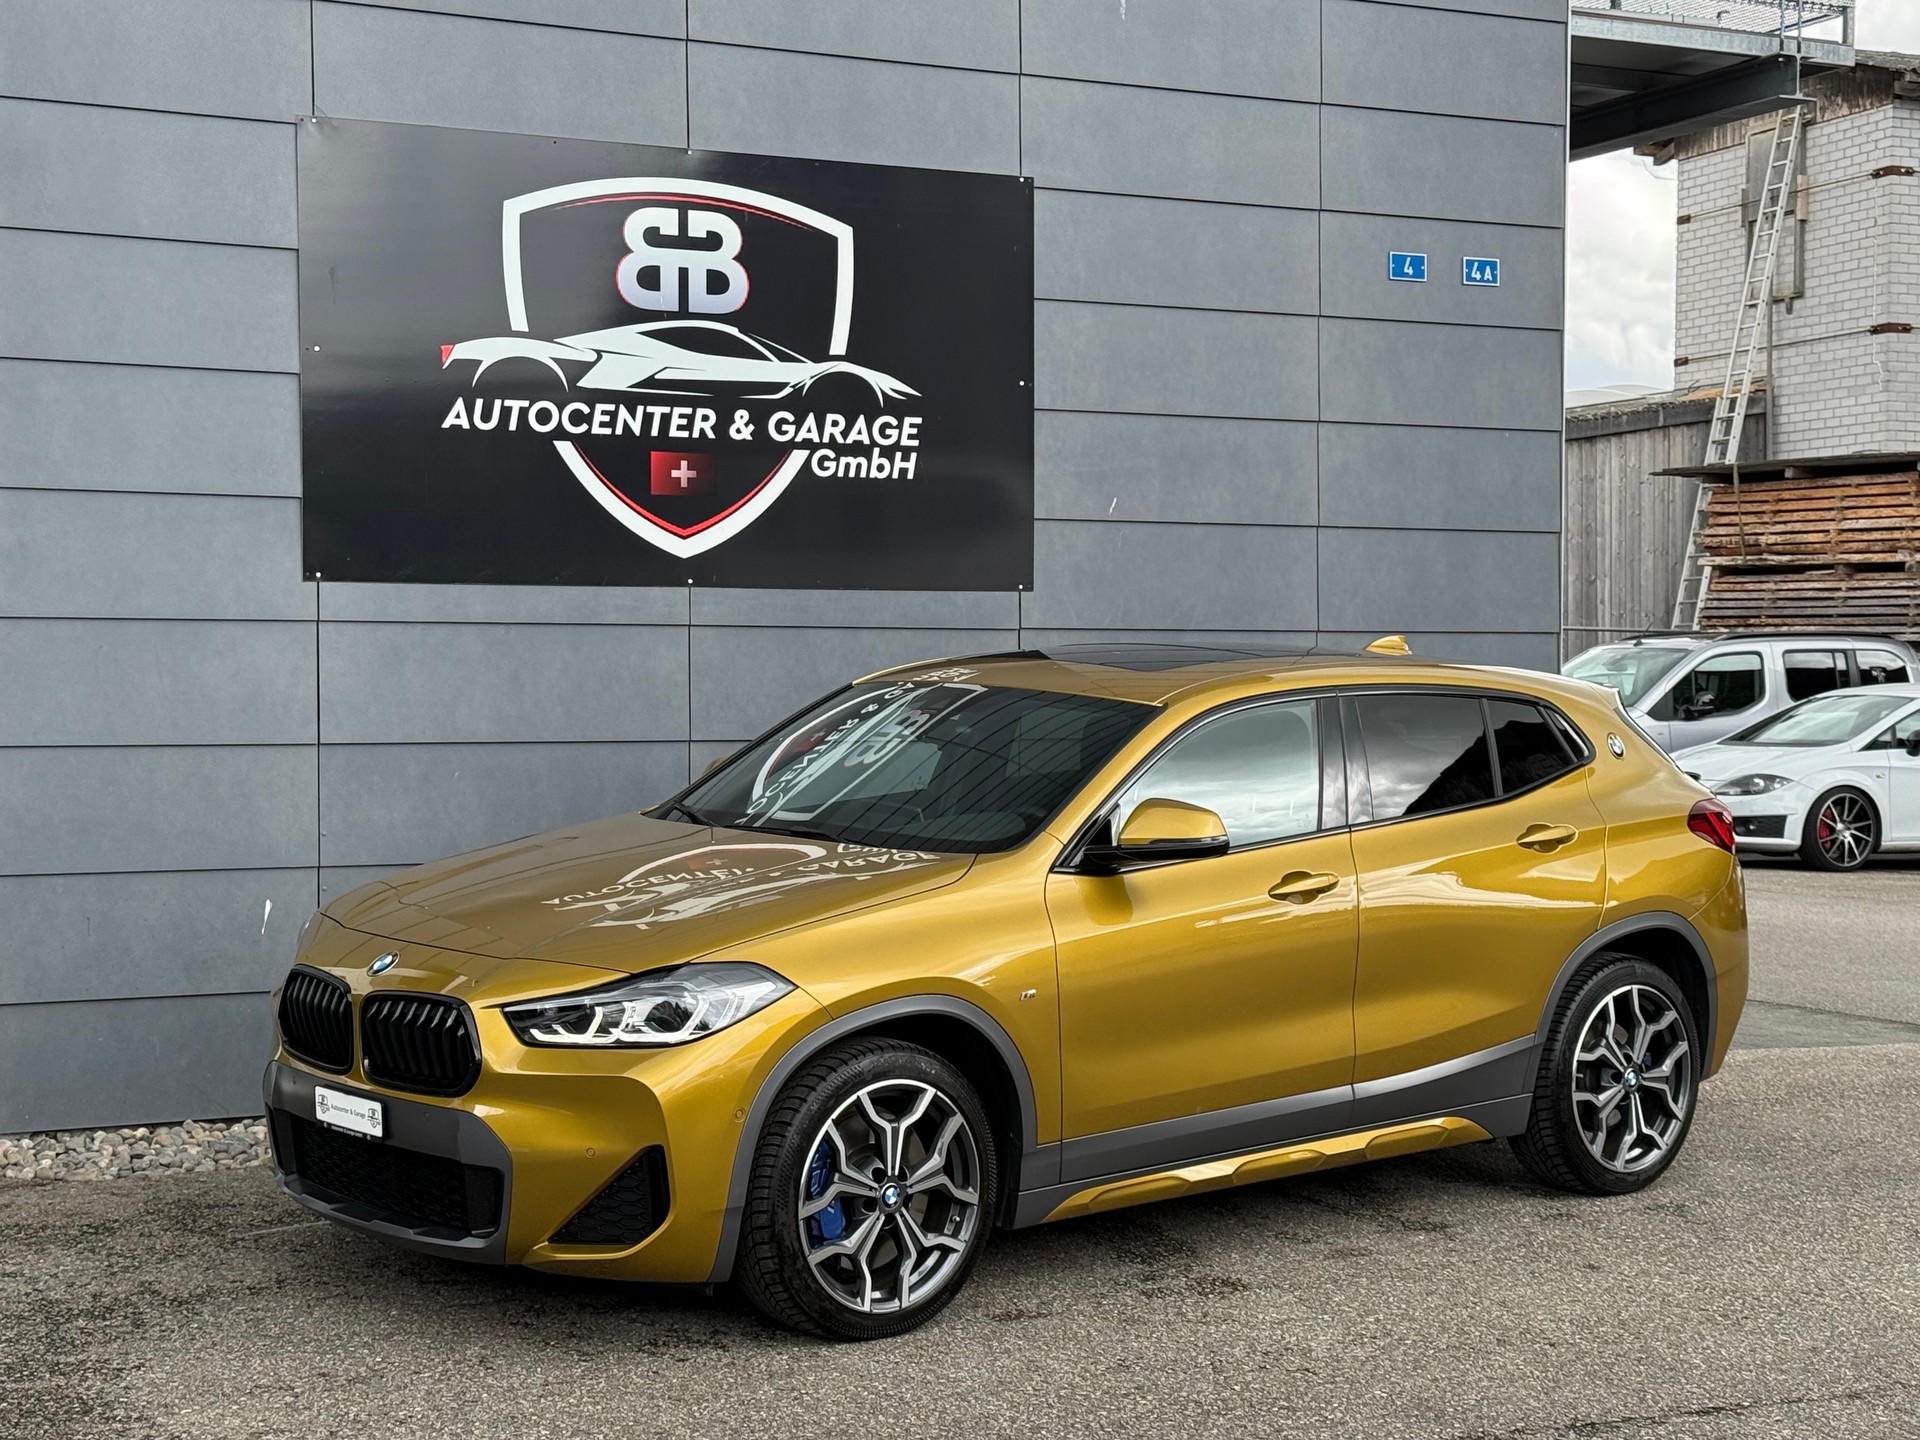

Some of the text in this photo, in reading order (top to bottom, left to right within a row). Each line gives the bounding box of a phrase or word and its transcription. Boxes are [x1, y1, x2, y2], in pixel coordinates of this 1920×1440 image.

[1403, 256, 1414, 276] 4
[1471, 261, 1493, 281] 4A
[441, 397, 923, 447] AUTOCENTER & GARAGE
[811, 448, 918, 480] GmbH
